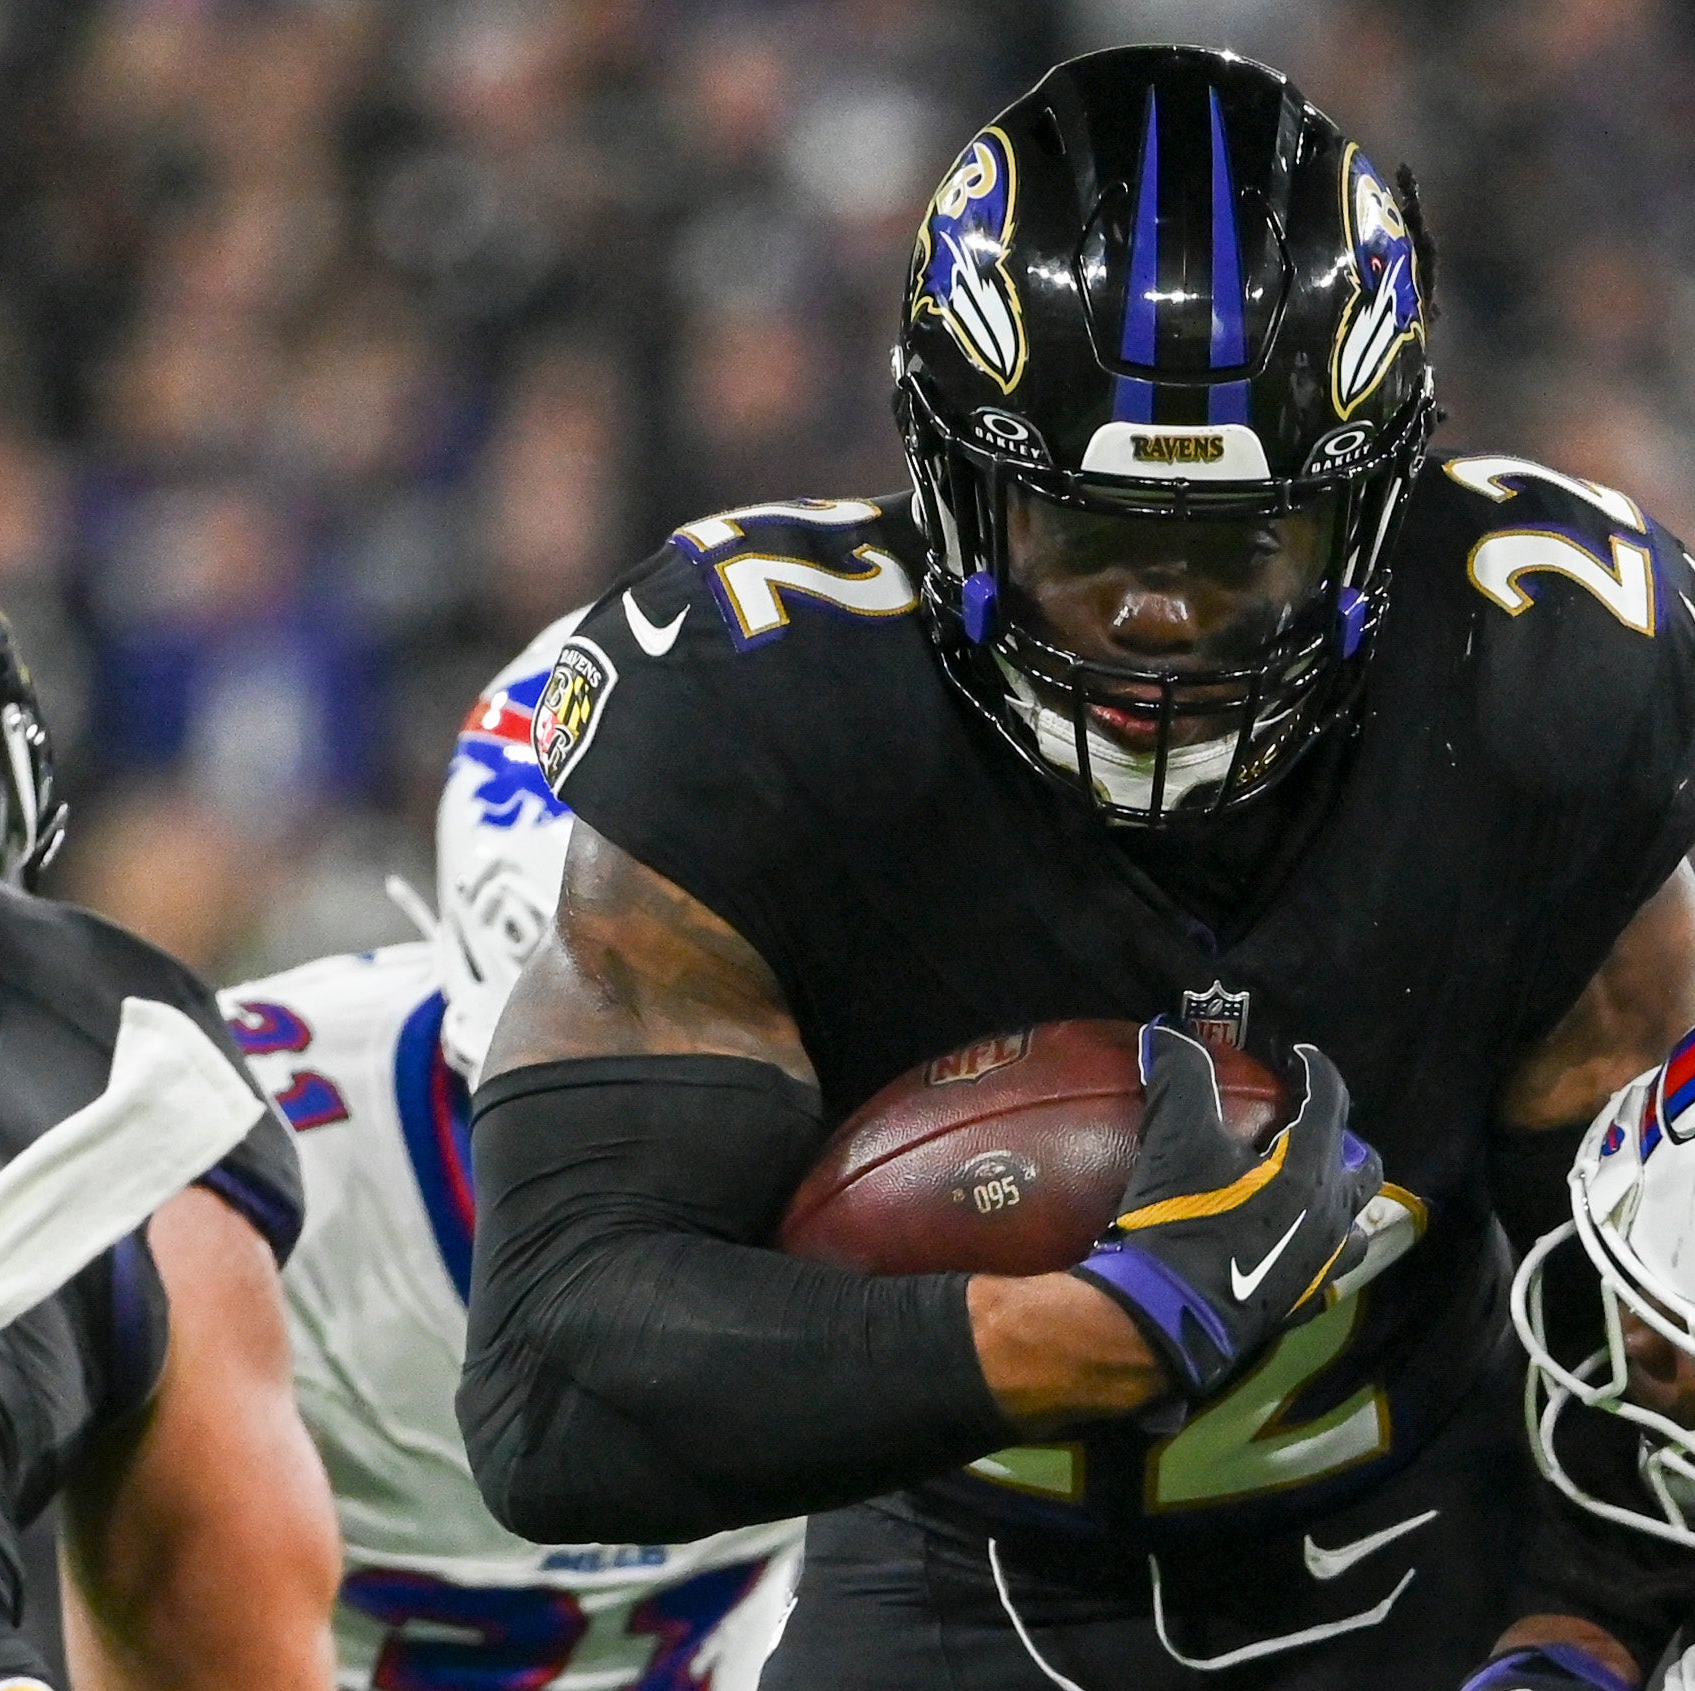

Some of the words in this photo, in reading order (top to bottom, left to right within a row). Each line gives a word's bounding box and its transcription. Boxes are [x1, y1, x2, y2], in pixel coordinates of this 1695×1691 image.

[974, 426, 1041, 459] OAKLEY
[1130, 434, 1225, 466] RAVENS
[1311, 443, 1372, 474] OAKLEY
[1442, 455, 1658, 638] 22
[670, 498, 920, 642] 22
[561, 649, 603, 689] RAVENS
[973, 1175, 1021, 1214] 095
